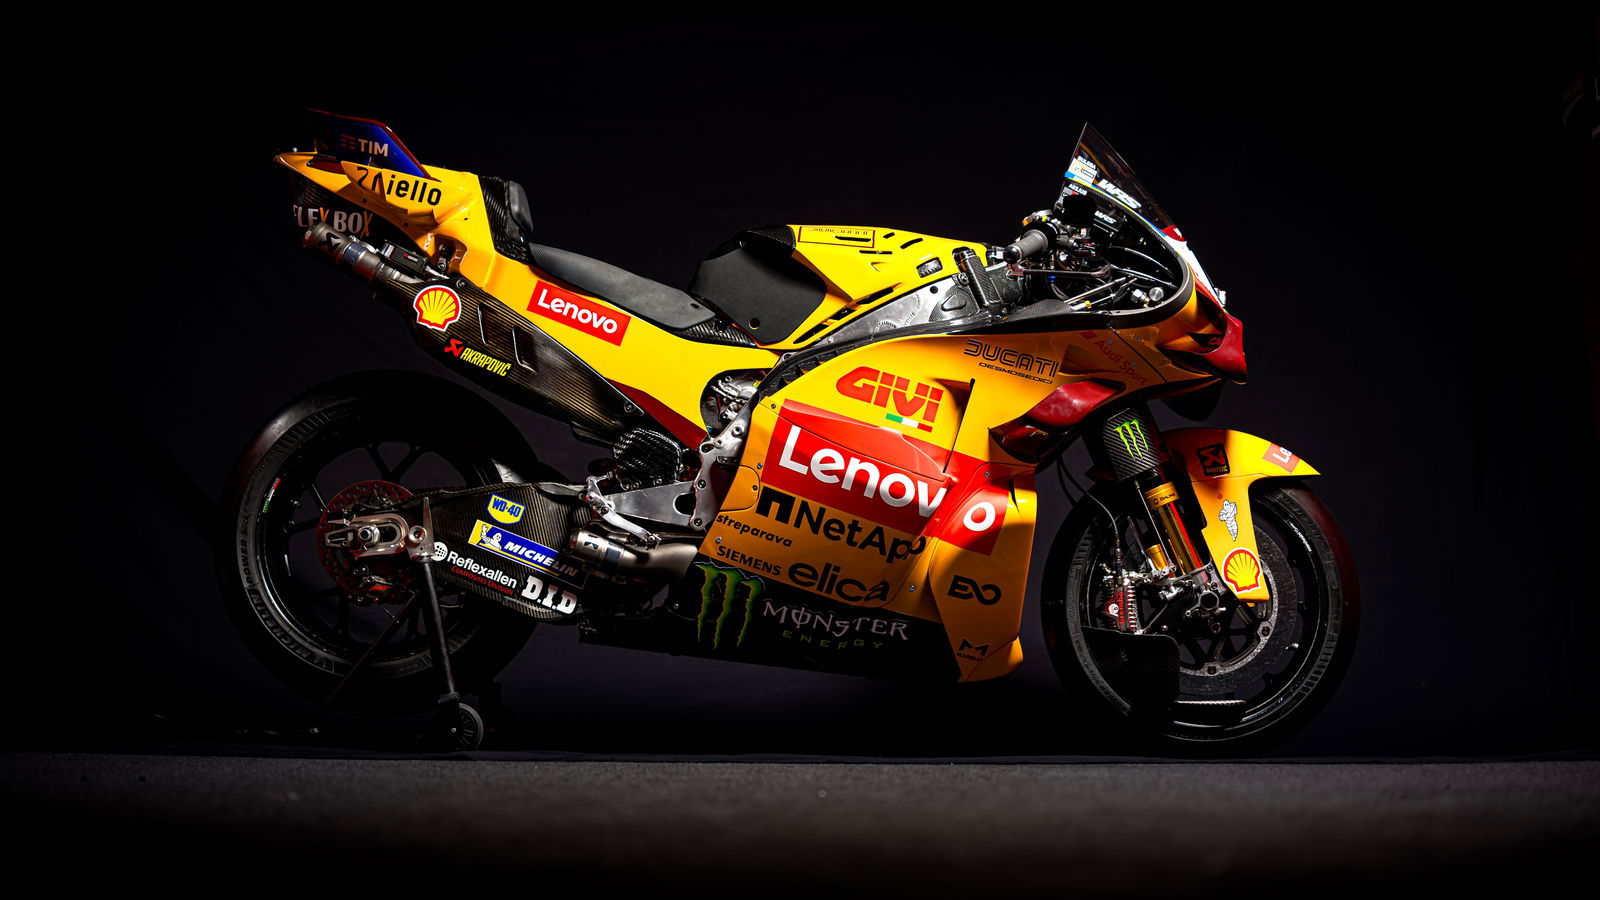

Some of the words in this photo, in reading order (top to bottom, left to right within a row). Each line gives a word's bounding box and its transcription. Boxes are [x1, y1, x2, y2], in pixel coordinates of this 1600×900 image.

[358, 138, 389, 158] TIM
[1098, 178, 1142, 209] WRS
[333, 209, 374, 241] BOX
[1094, 210, 1117, 224] WRS
[537, 288, 618, 335] Lenovo
[963, 338, 1059, 378] DUCATI
[978, 361, 1054, 385] DESMOSEDICI
[1094, 340, 1121, 365] Audi
[1119, 360, 1149, 386] Sport
[836, 365, 944, 424] GIVI
[778, 425, 996, 532] Lenovo
[491, 497, 522, 518] WD-40
[716, 513, 793, 548] streparava
[793, 501, 926, 564] NetApp
[447, 550, 517, 589] Reflexallen
[504, 541, 578, 577] MICHELIN
[717, 545, 781, 576] SIEMENS
[487, 579, 515, 596] DIVISION
[787, 562, 890, 603] elica
[762, 597, 910, 641] MONSTER
[782, 629, 883, 649] ENERGY
